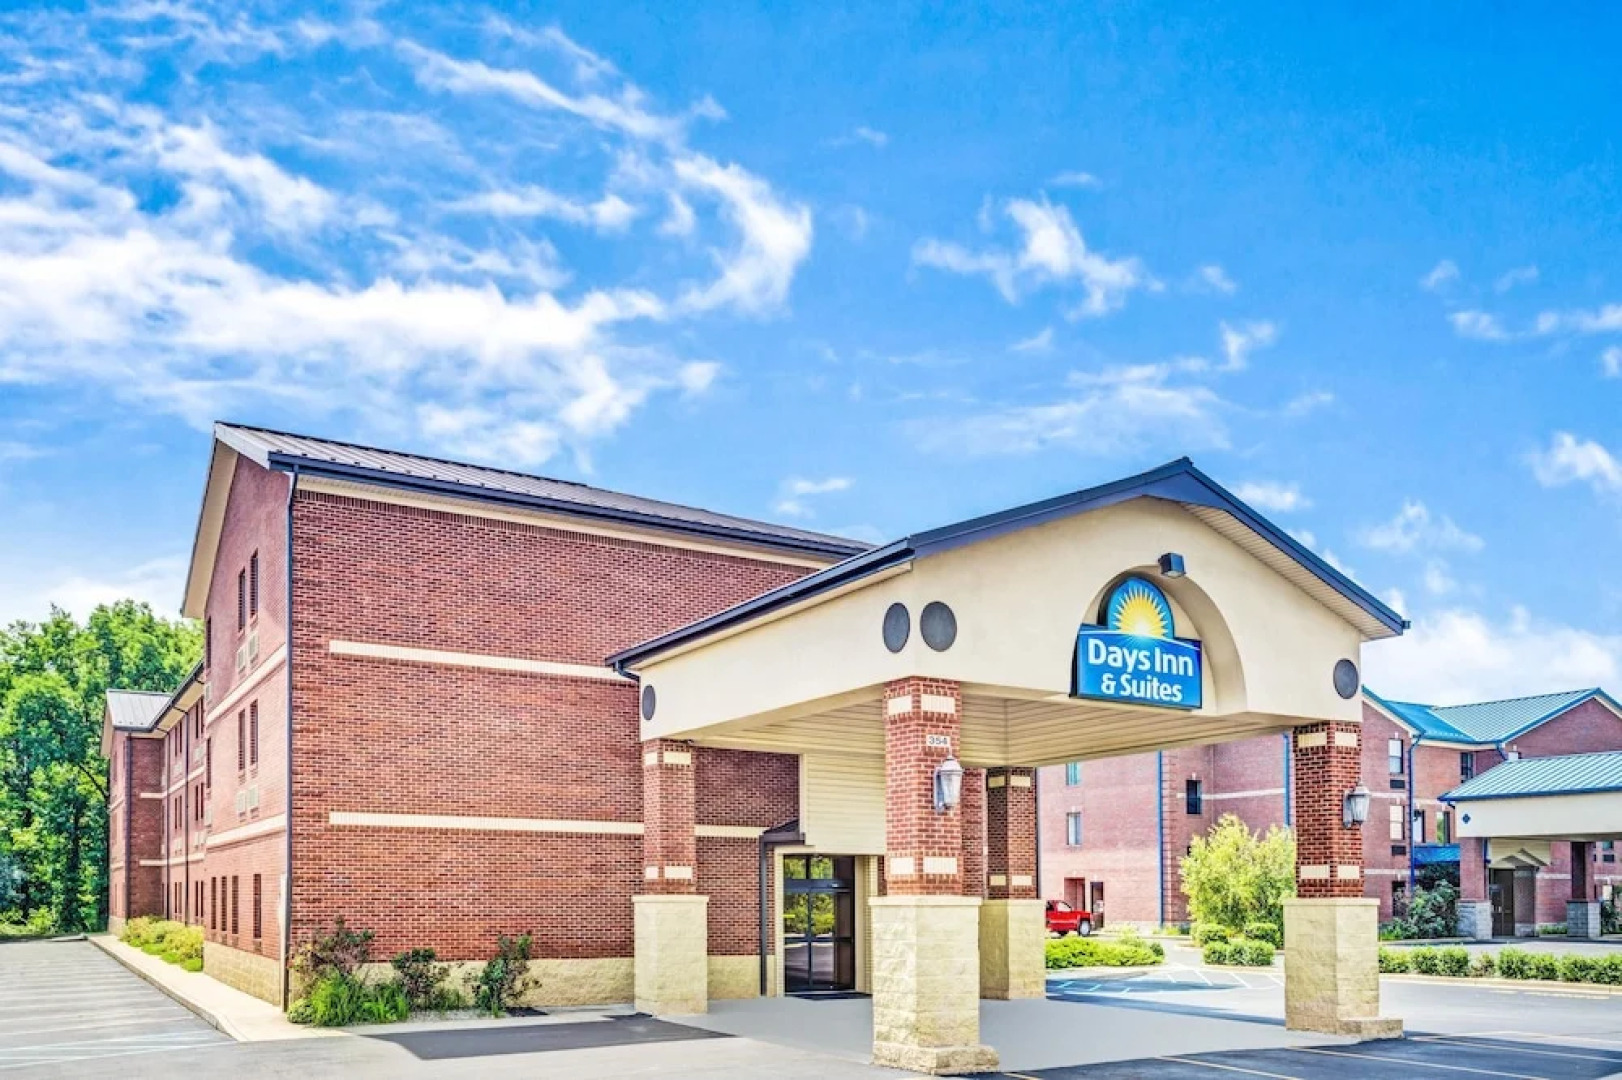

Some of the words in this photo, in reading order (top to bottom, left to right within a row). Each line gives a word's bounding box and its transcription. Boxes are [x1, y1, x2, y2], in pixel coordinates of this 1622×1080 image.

[1087, 638, 1151, 673] Days
[1154, 647, 1194, 677] Inn
[1101, 673, 1117, 695] &
[1119, 673, 1183, 702] Suites
[928, 735, 948, 745] 354
